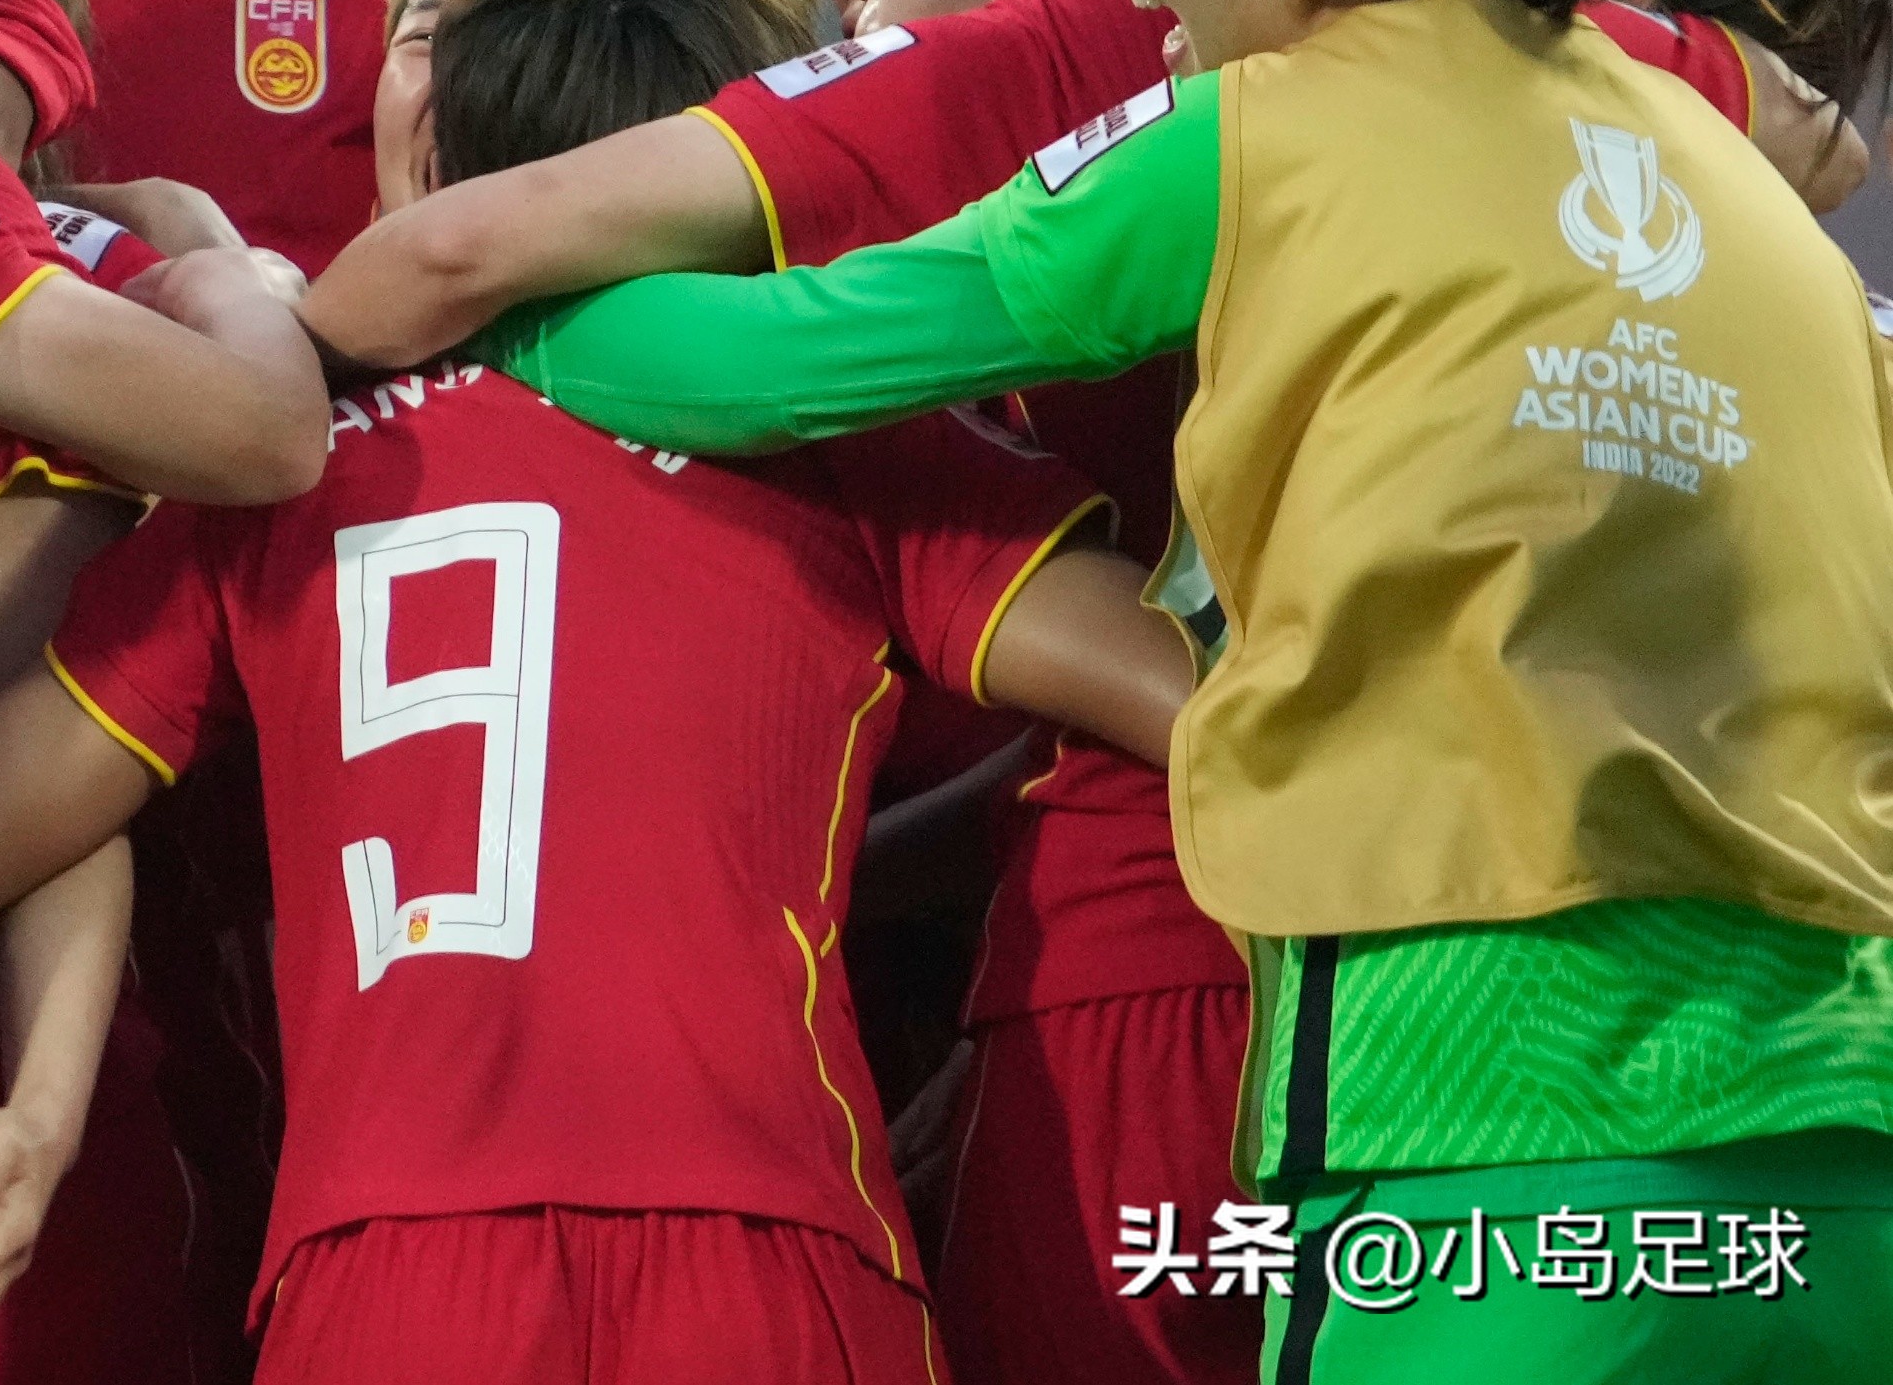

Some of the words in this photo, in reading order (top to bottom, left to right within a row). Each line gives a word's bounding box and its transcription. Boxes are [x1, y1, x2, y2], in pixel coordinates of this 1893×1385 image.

[1608, 318, 1678, 361] AFC
[1525, 345, 1740, 427] WOMEN'S
[1512, 387, 1662, 445] ASIAN
[1582, 439, 1644, 477] INDIA
[1649, 451, 1701, 496] 2022
[334, 502, 560, 992] 9
